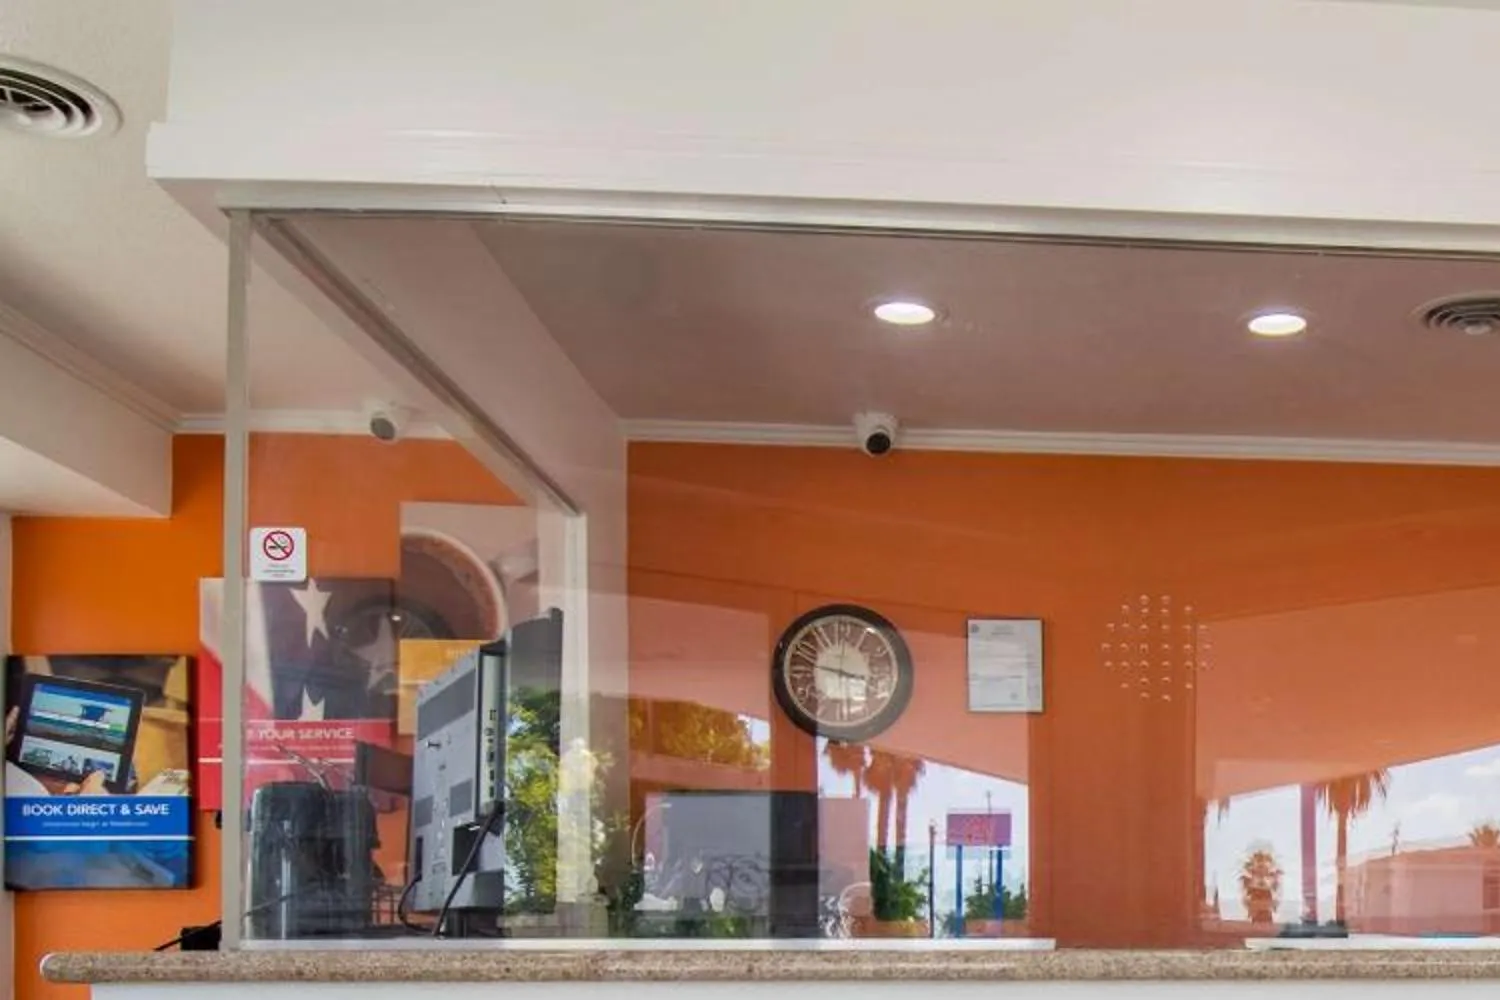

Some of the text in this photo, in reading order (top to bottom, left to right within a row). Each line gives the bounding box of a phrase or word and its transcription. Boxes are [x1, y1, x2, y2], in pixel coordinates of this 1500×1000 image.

[258, 728, 295, 740] YOUR
[299, 728, 355, 740] SERVICE
[22, 803, 170, 816] BOOK DIRECT & SAVE
